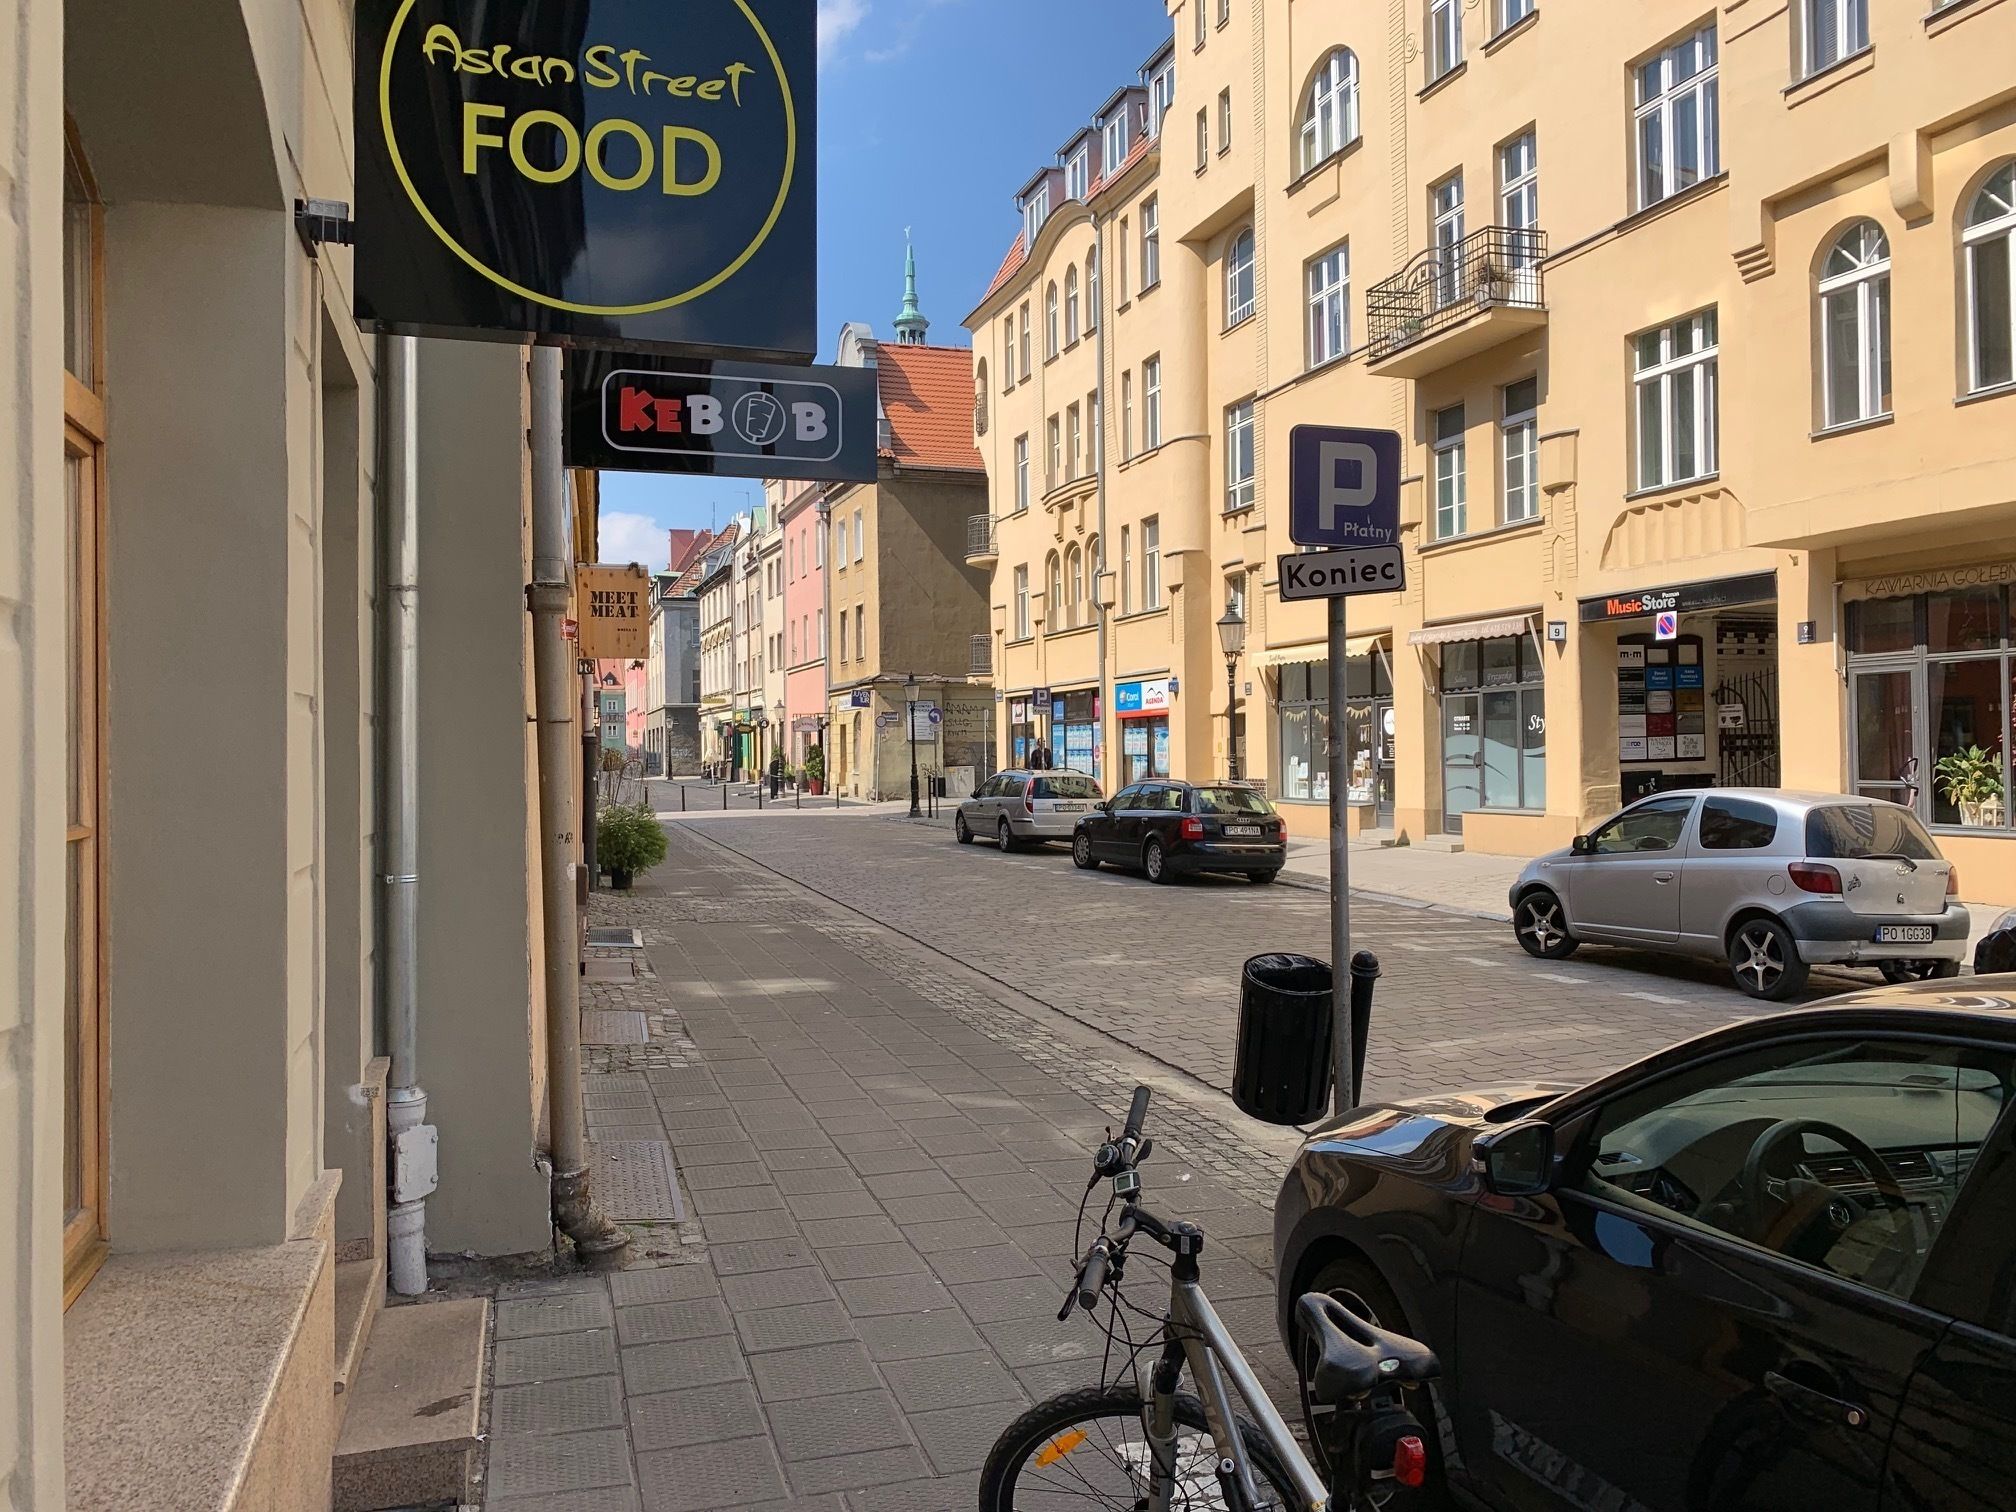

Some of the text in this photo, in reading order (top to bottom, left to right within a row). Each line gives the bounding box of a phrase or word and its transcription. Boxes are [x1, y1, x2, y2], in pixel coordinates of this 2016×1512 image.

[423, 24, 755, 107] Asian Street
[463, 102, 722, 195] FOOD
[1319, 441, 1378, 530] P
[1344, 522, 1392, 542] Płatny
[1287, 558, 1396, 589] Koniec
[1865, 572, 1949, 596] KAWIARNIA
[590, 591, 638, 604] MEET
[590, 605, 638, 618] MEAT
[1554, 628, 1560, 637] 9
[1803, 625, 1809, 634] 9
[1037, 690, 1047, 705] P
[1145, 697, 1164, 705] AGENDA
[1228, 826, 1239, 834] PO
[1882, 927, 1931, 940] PO 1GG38
